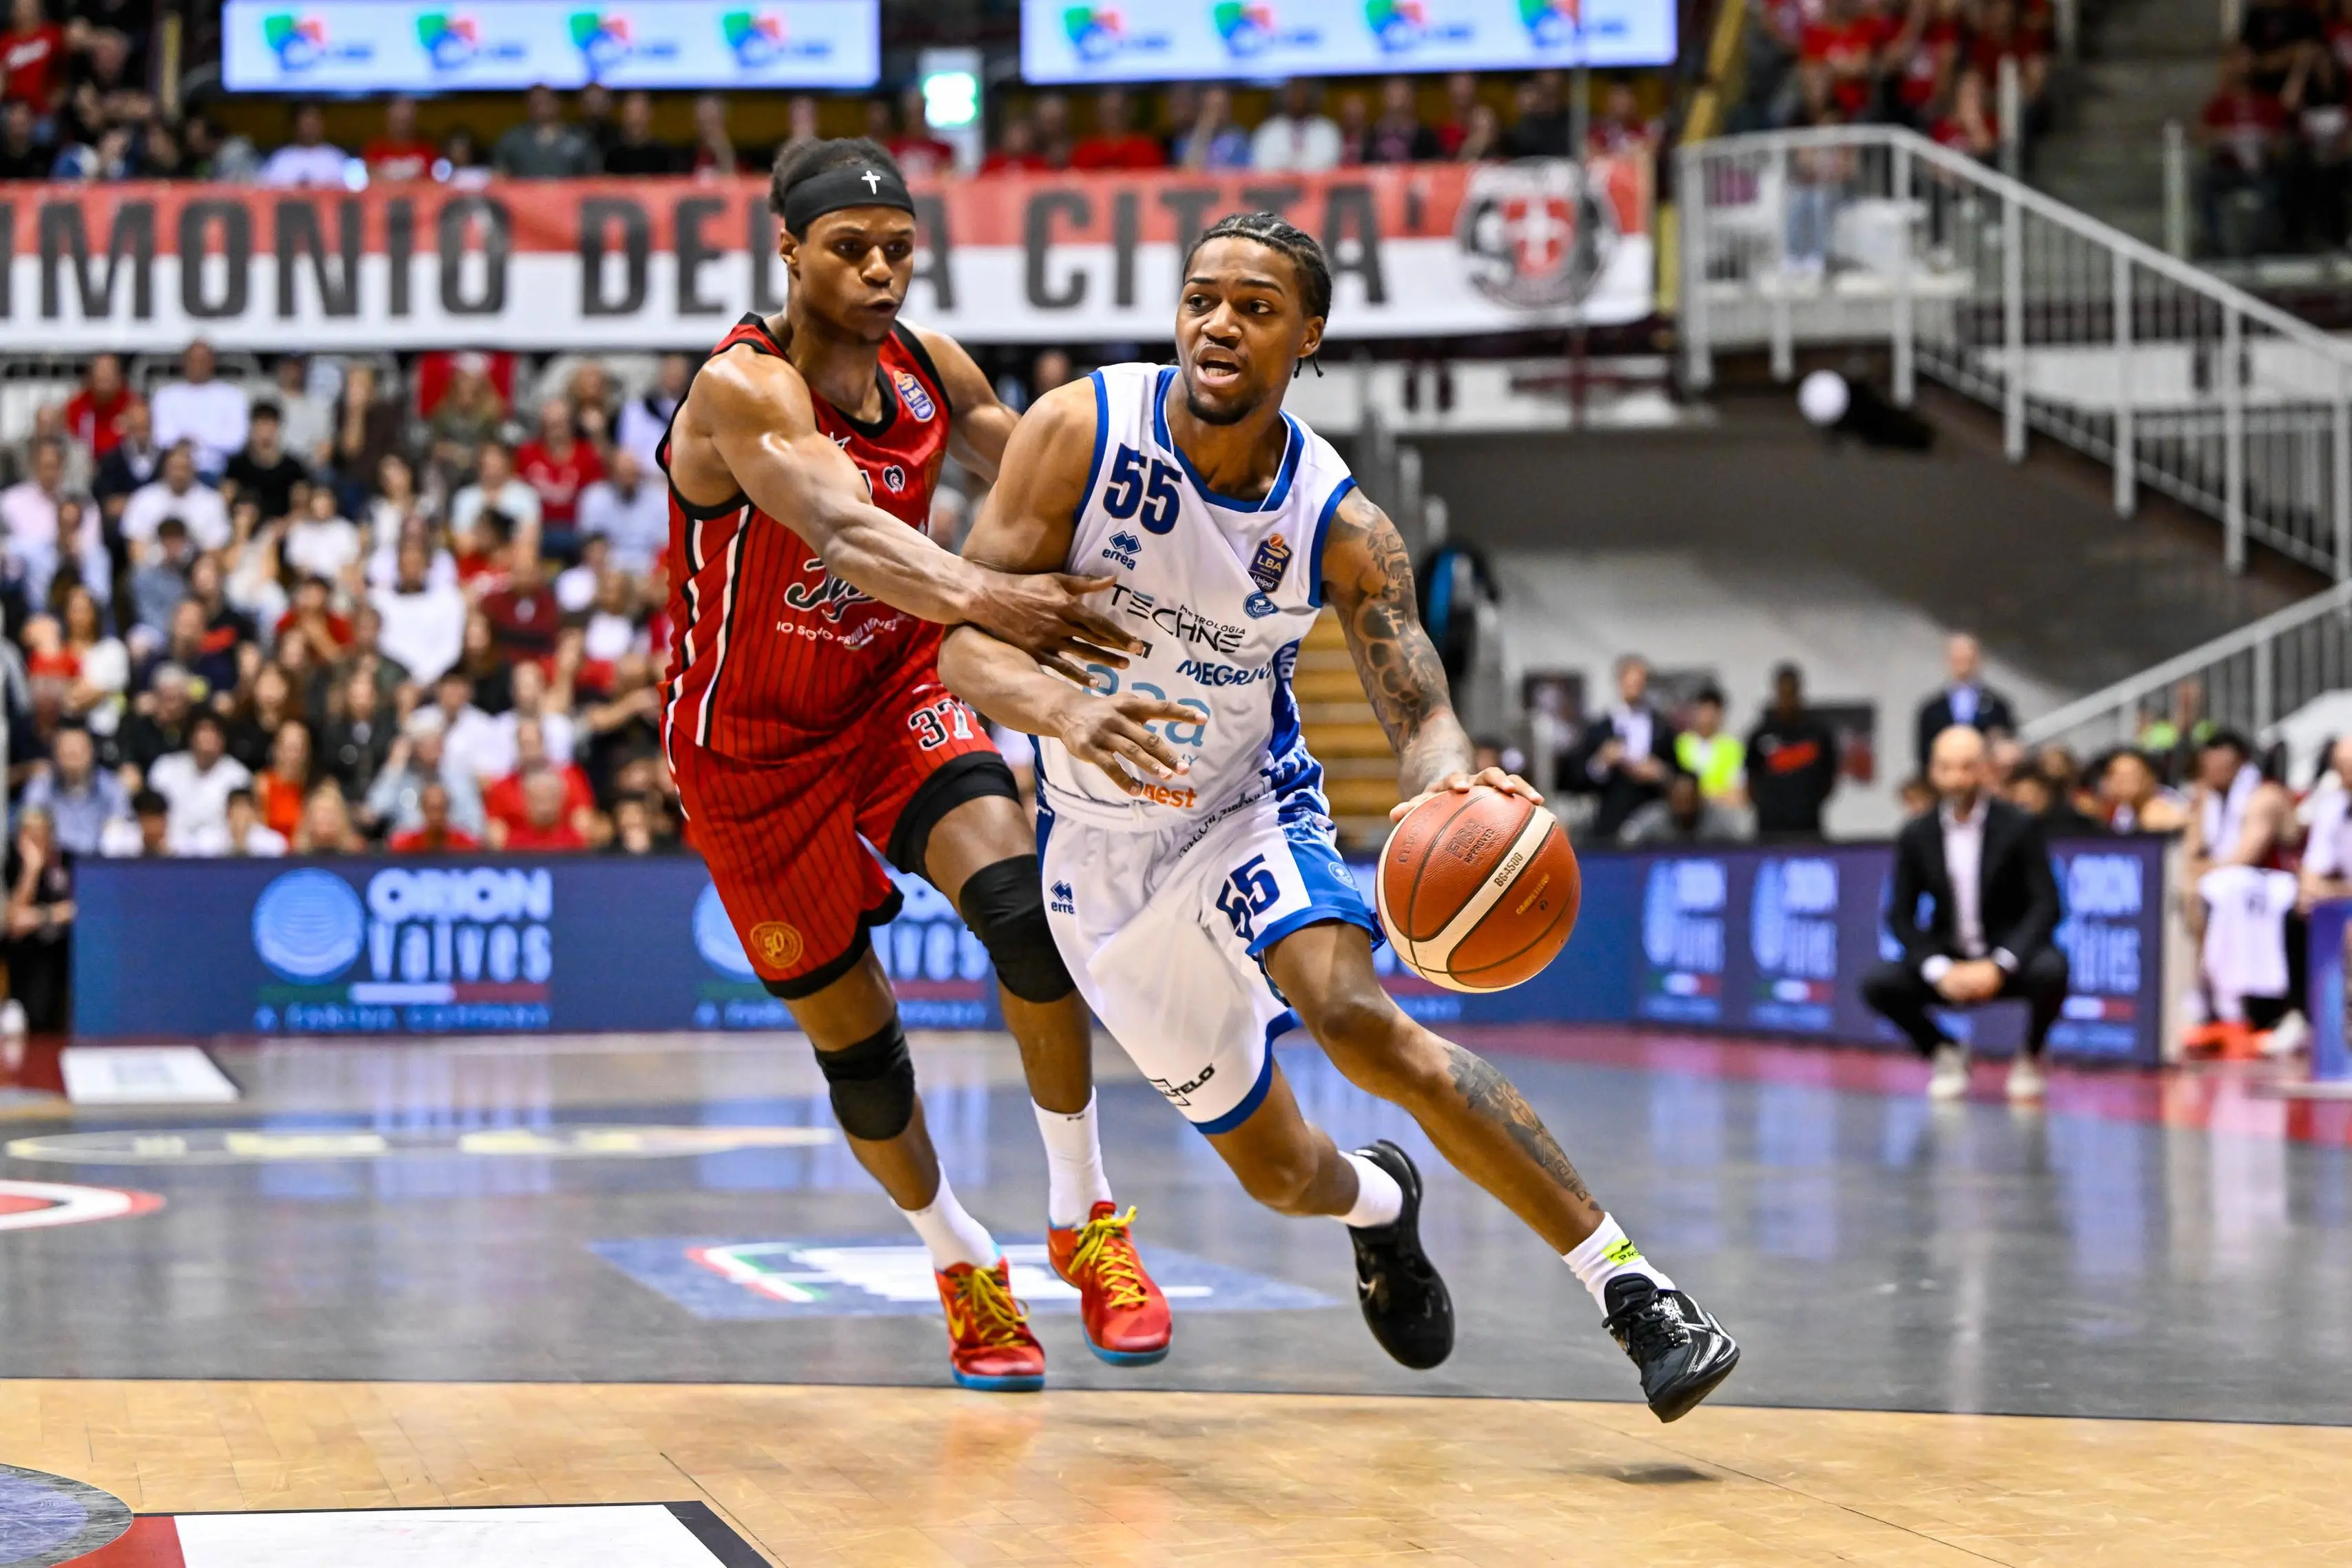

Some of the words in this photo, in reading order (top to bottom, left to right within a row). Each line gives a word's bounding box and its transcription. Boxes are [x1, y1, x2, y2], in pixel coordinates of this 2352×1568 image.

[580, 193, 954, 316] DELA
[1103, 443, 1183, 535] 55
[1257, 555, 1281, 572] LBA
[1254, 575, 1275, 588] Unipol
[776, 621, 794, 634] IO
[1179, 604, 1246, 635] METROLOGIA
[907, 698, 973, 751] 37
[1463, 829, 1494, 864] APPROVED
[1051, 900, 1076, 915] erre
[1216, 852, 1280, 943] 55
